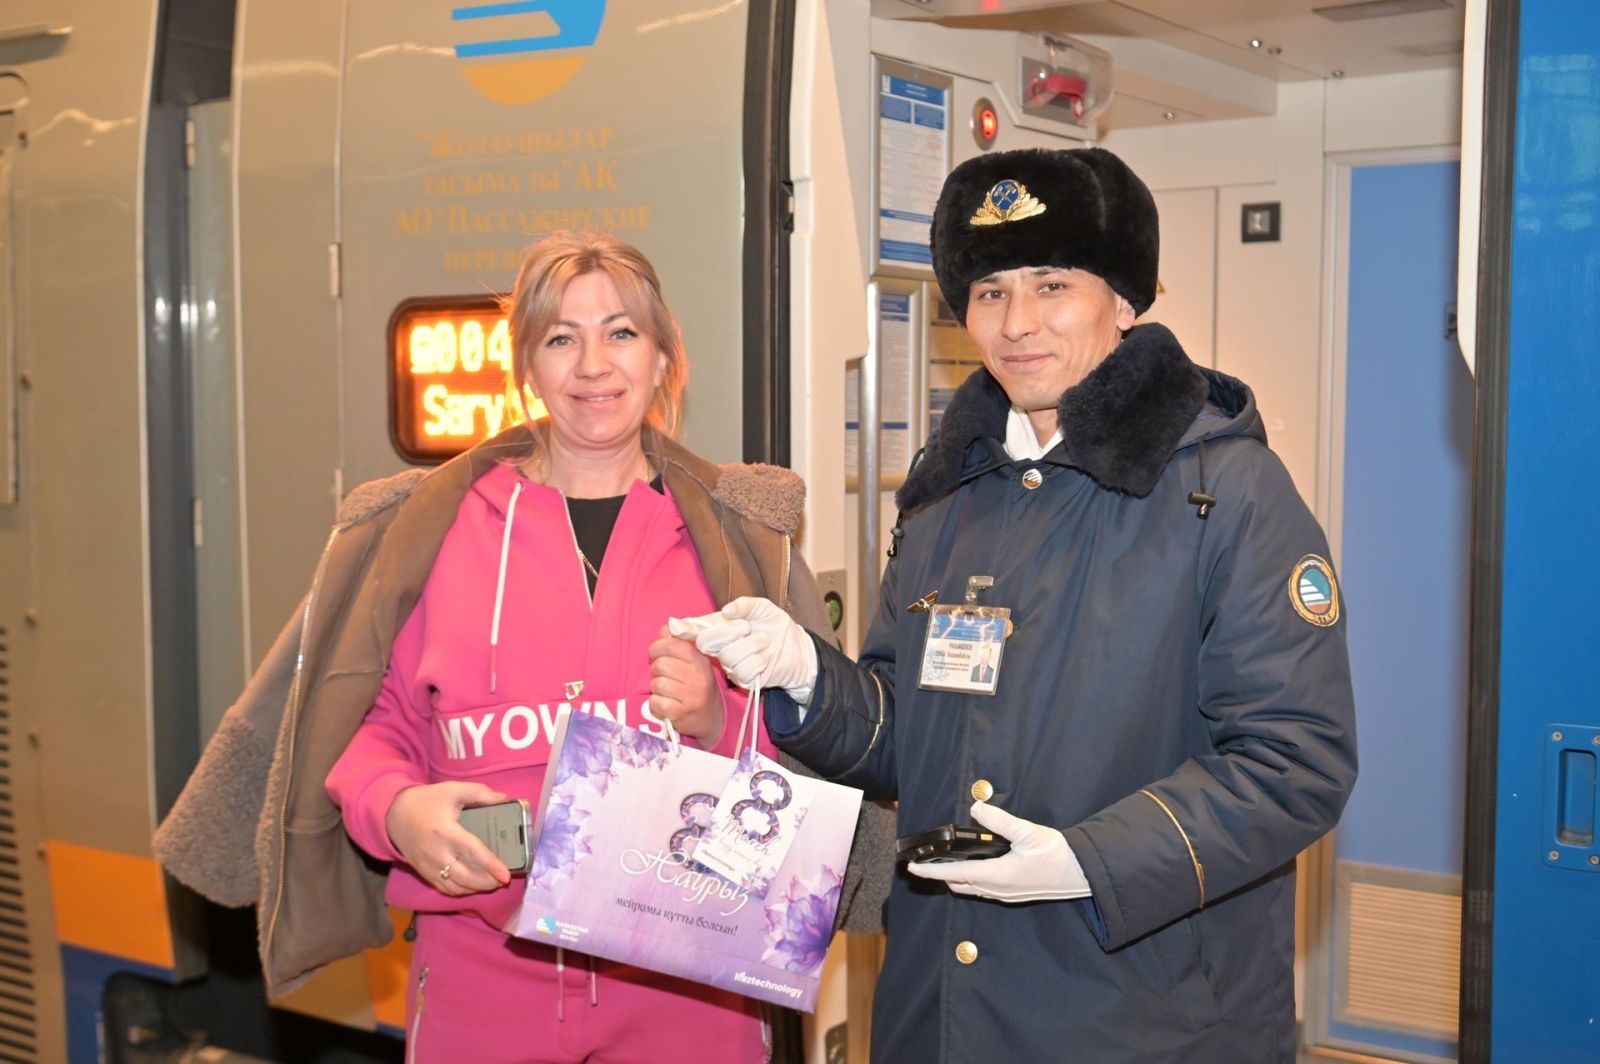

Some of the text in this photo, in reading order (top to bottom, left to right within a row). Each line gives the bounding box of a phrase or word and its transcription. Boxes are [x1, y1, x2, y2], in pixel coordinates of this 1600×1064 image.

[438, 712, 495, 760] MY
[639, 700, 669, 741] S
[731, 770, 793, 845] 8
[619, 848, 751, 917] Наурыз
[615, 897, 662, 917] мейрамы
[695, 916, 739, 937] болсын!
